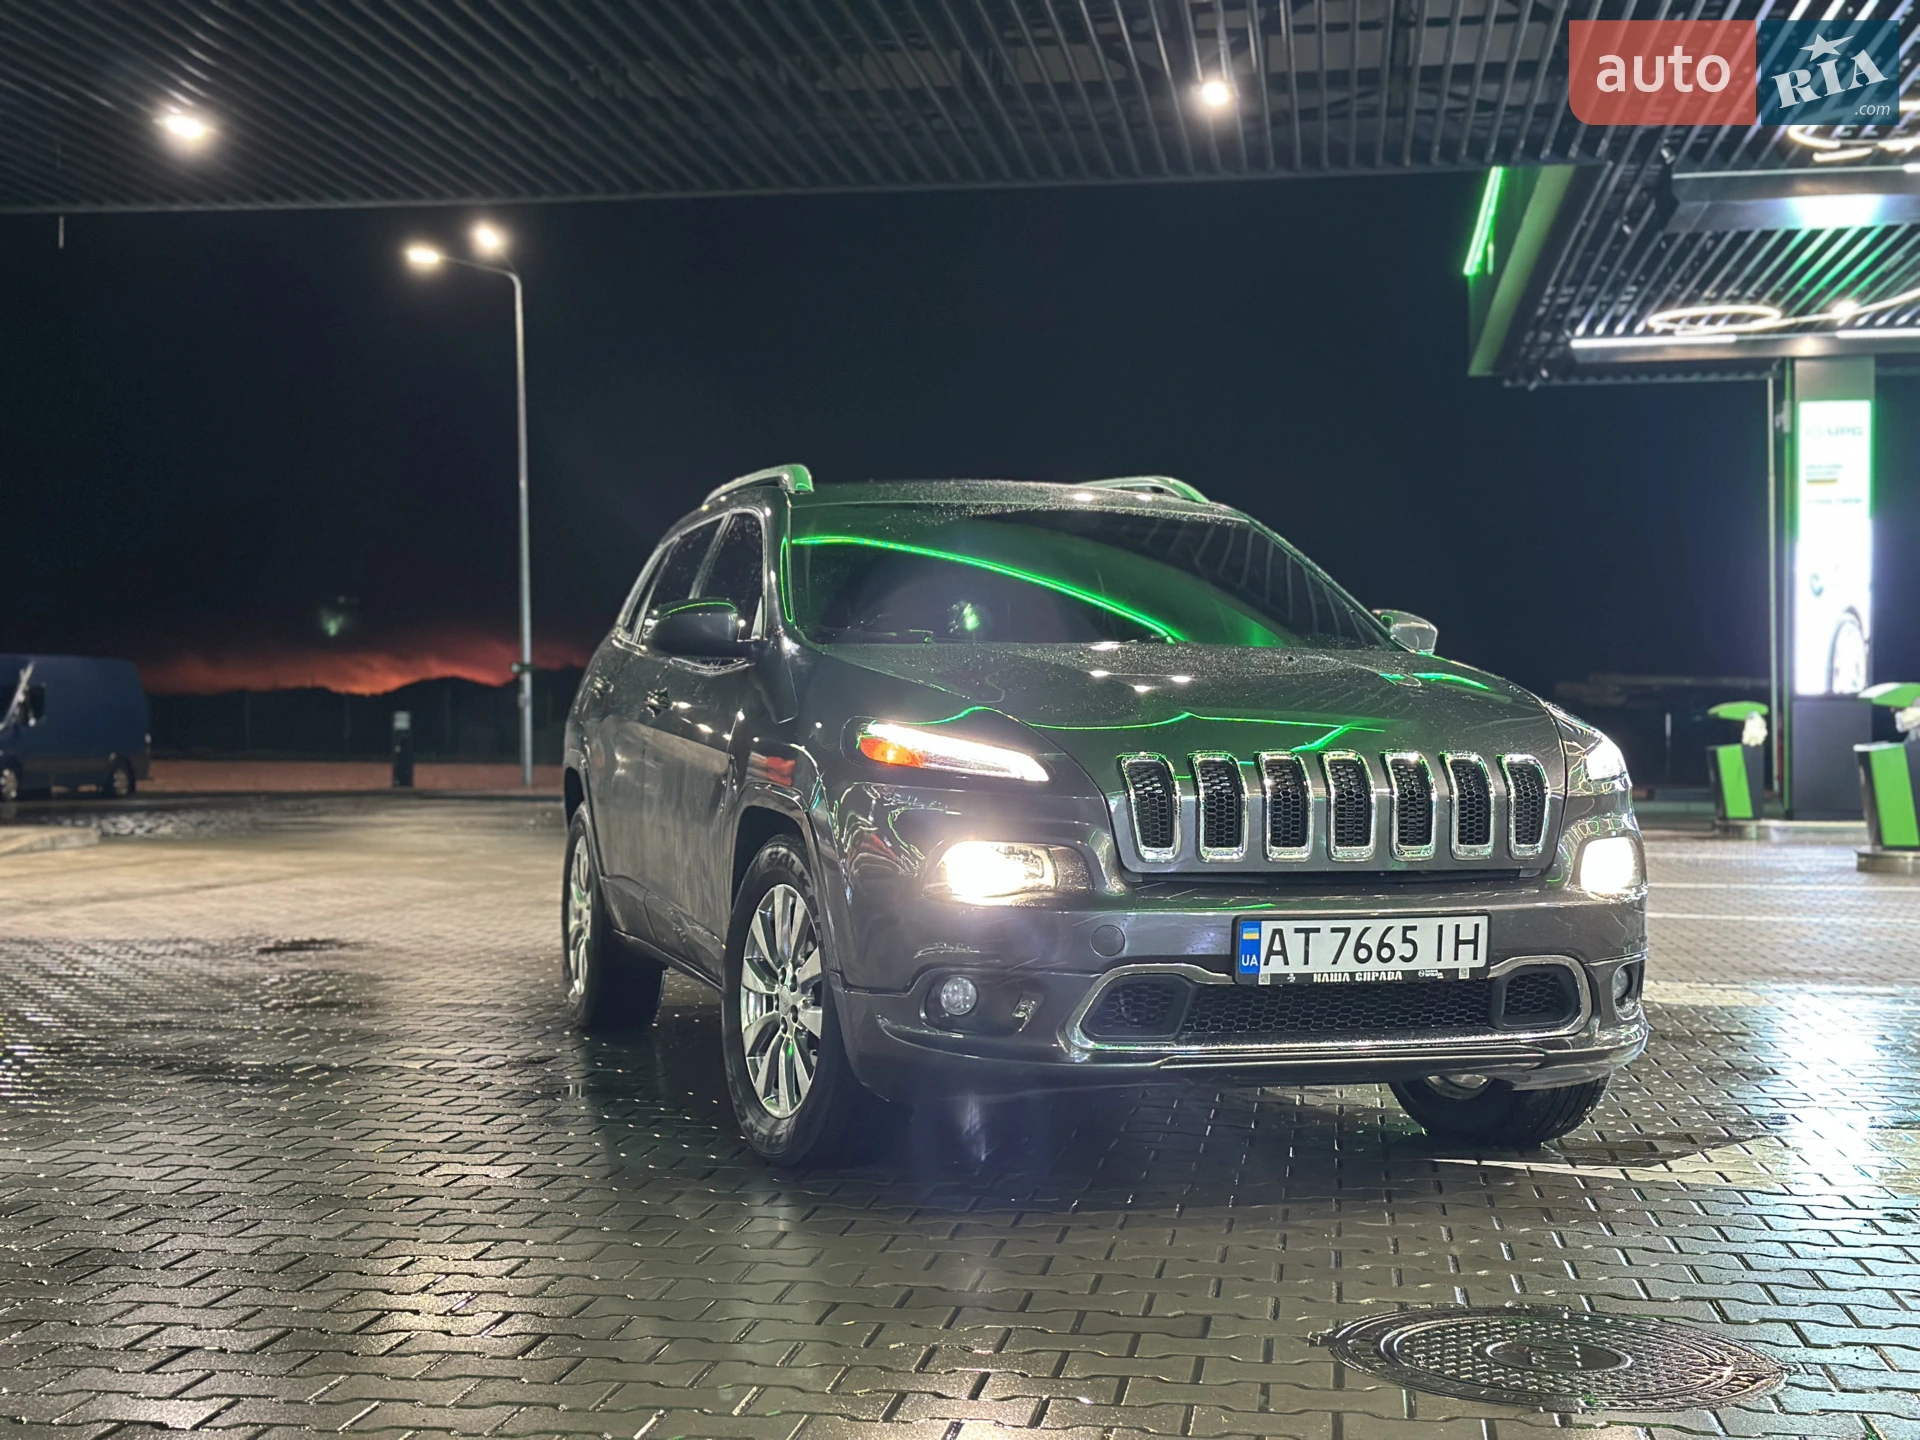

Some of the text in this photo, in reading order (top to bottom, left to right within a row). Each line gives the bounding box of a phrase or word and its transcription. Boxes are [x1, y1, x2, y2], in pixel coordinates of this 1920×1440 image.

[1263, 923, 1480, 966] AT 7665 IH
[1241, 955, 1258, 967] UA
[1313, 970, 1402, 983] НАША СПРАВА
